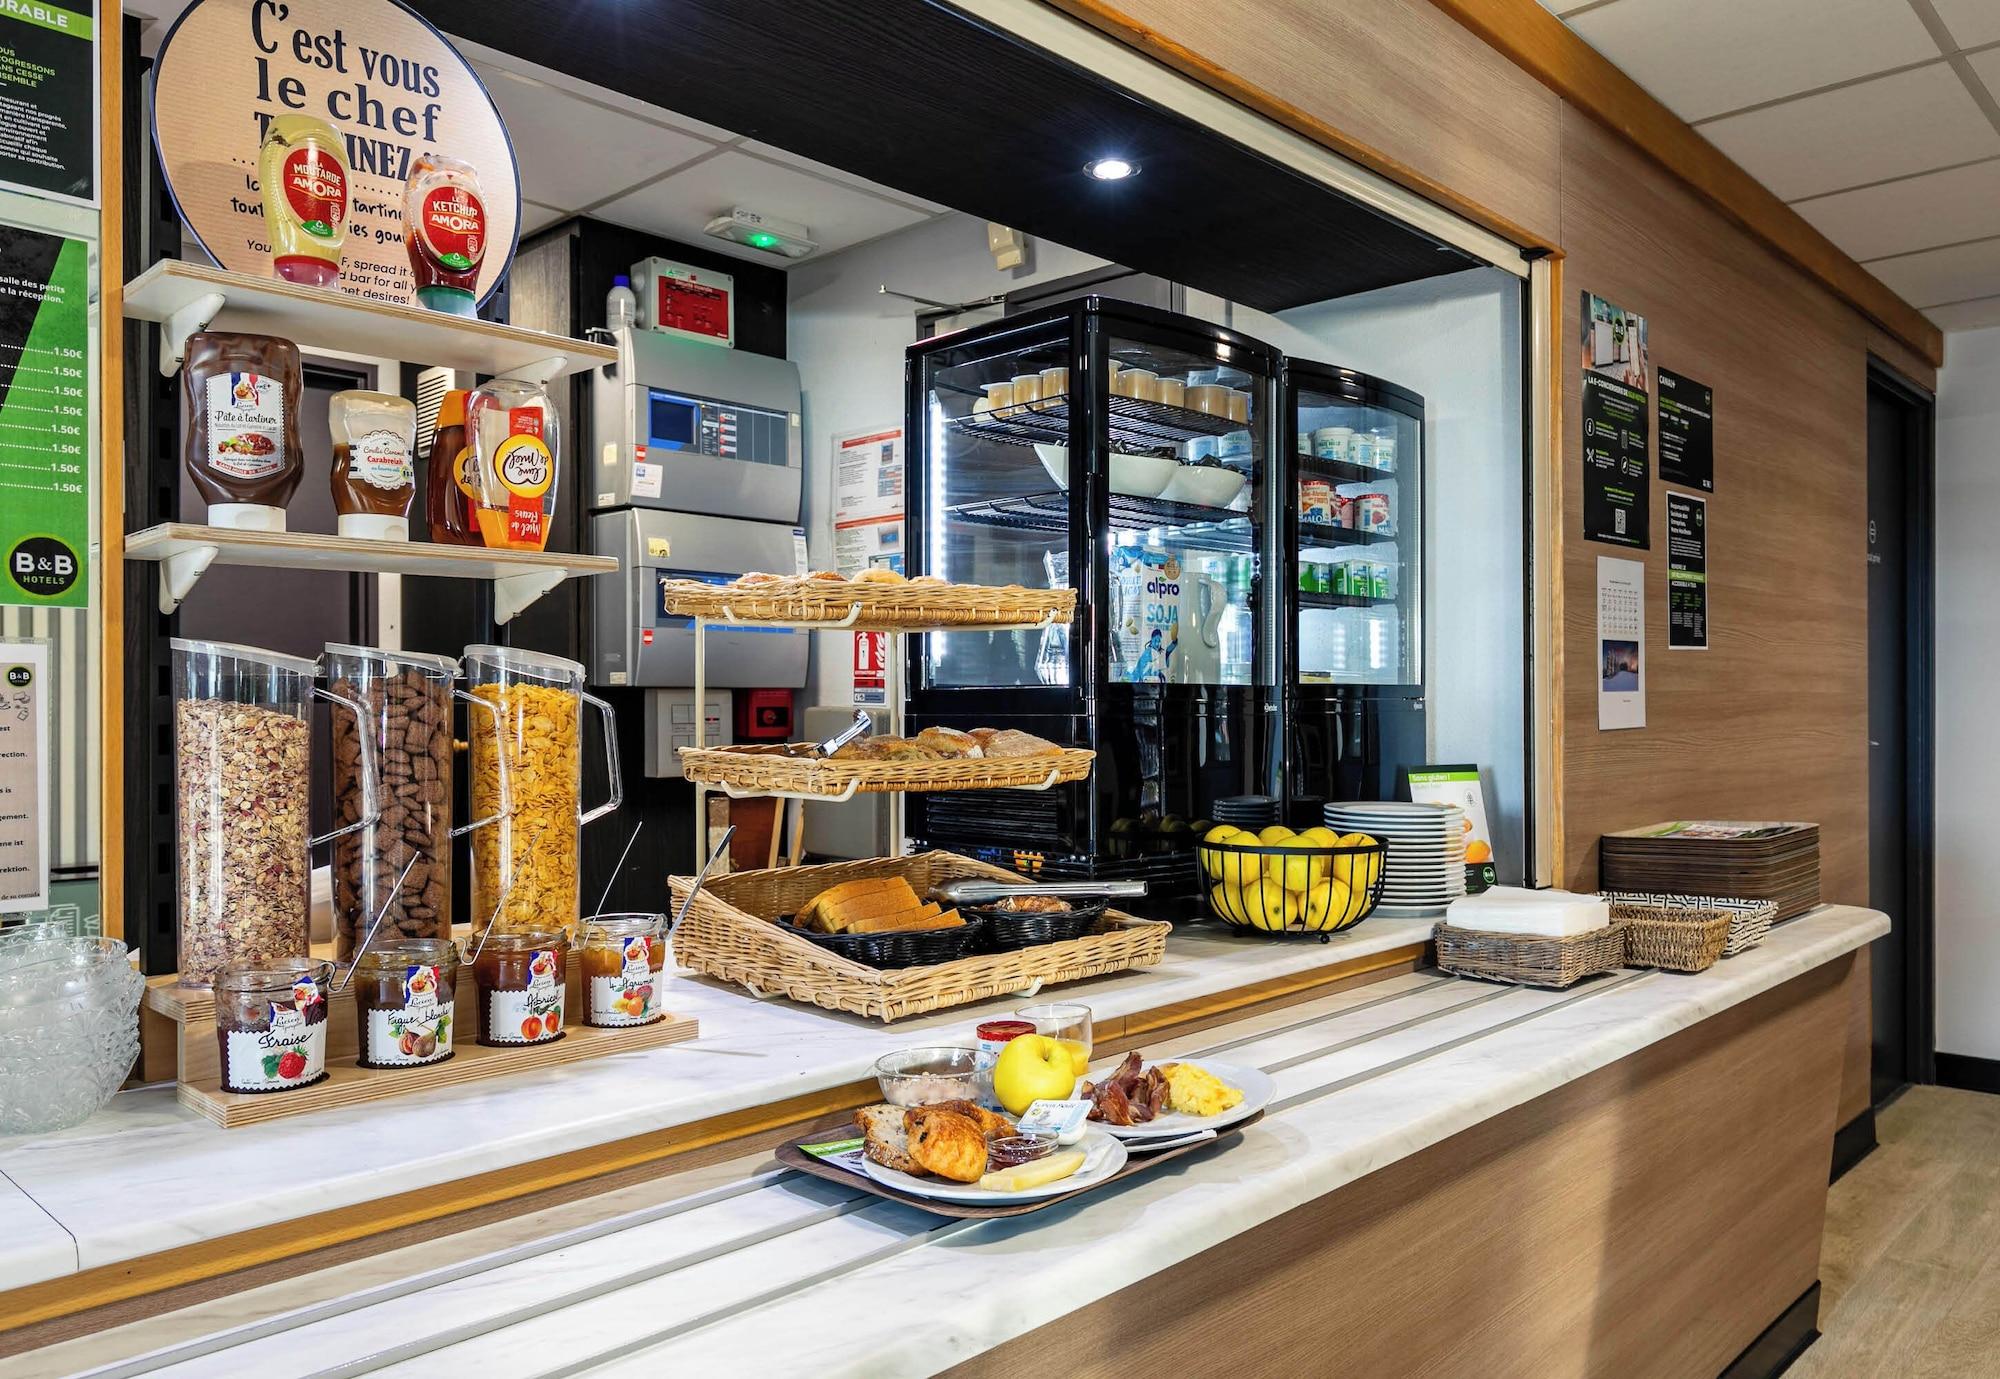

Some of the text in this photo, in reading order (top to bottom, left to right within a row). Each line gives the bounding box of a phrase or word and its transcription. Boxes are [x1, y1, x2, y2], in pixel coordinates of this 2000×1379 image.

[0, 56, 56, 76] OGRESSONS
[358, 47, 441, 98] vous
[0, 71, 37, 88] SEMBLE
[255, 57, 442, 142] le chef
[293, 163, 342, 185] MOUTARDE
[293, 177, 342, 197] AMORA
[432, 200, 478, 218] KETCHUP
[431, 214, 479, 231] AMORA
[354, 260, 398, 276] spread
[400, 265, 409, 277] it
[22, 280, 38, 289] des
[39, 284, 65, 294] petits
[350, 272, 372, 284] bar
[374, 275, 390, 287] for
[393, 278, 408, 291] all
[8, 287, 17, 295] la
[18, 290, 64, 304] réception.
[363, 286, 410, 305] desires!
[215, 410, 236, 422] Pâte
[245, 412, 277, 424] tartiner
[515, 509, 539, 523] Fleurs
[511, 521, 541, 537] Miel de
[23, 575, 65, 585] HOTELS
[1146, 576, 1180, 599] alpro
[1146, 604, 1178, 623] SOJA
[258, 1029, 314, 1050] Fraise
